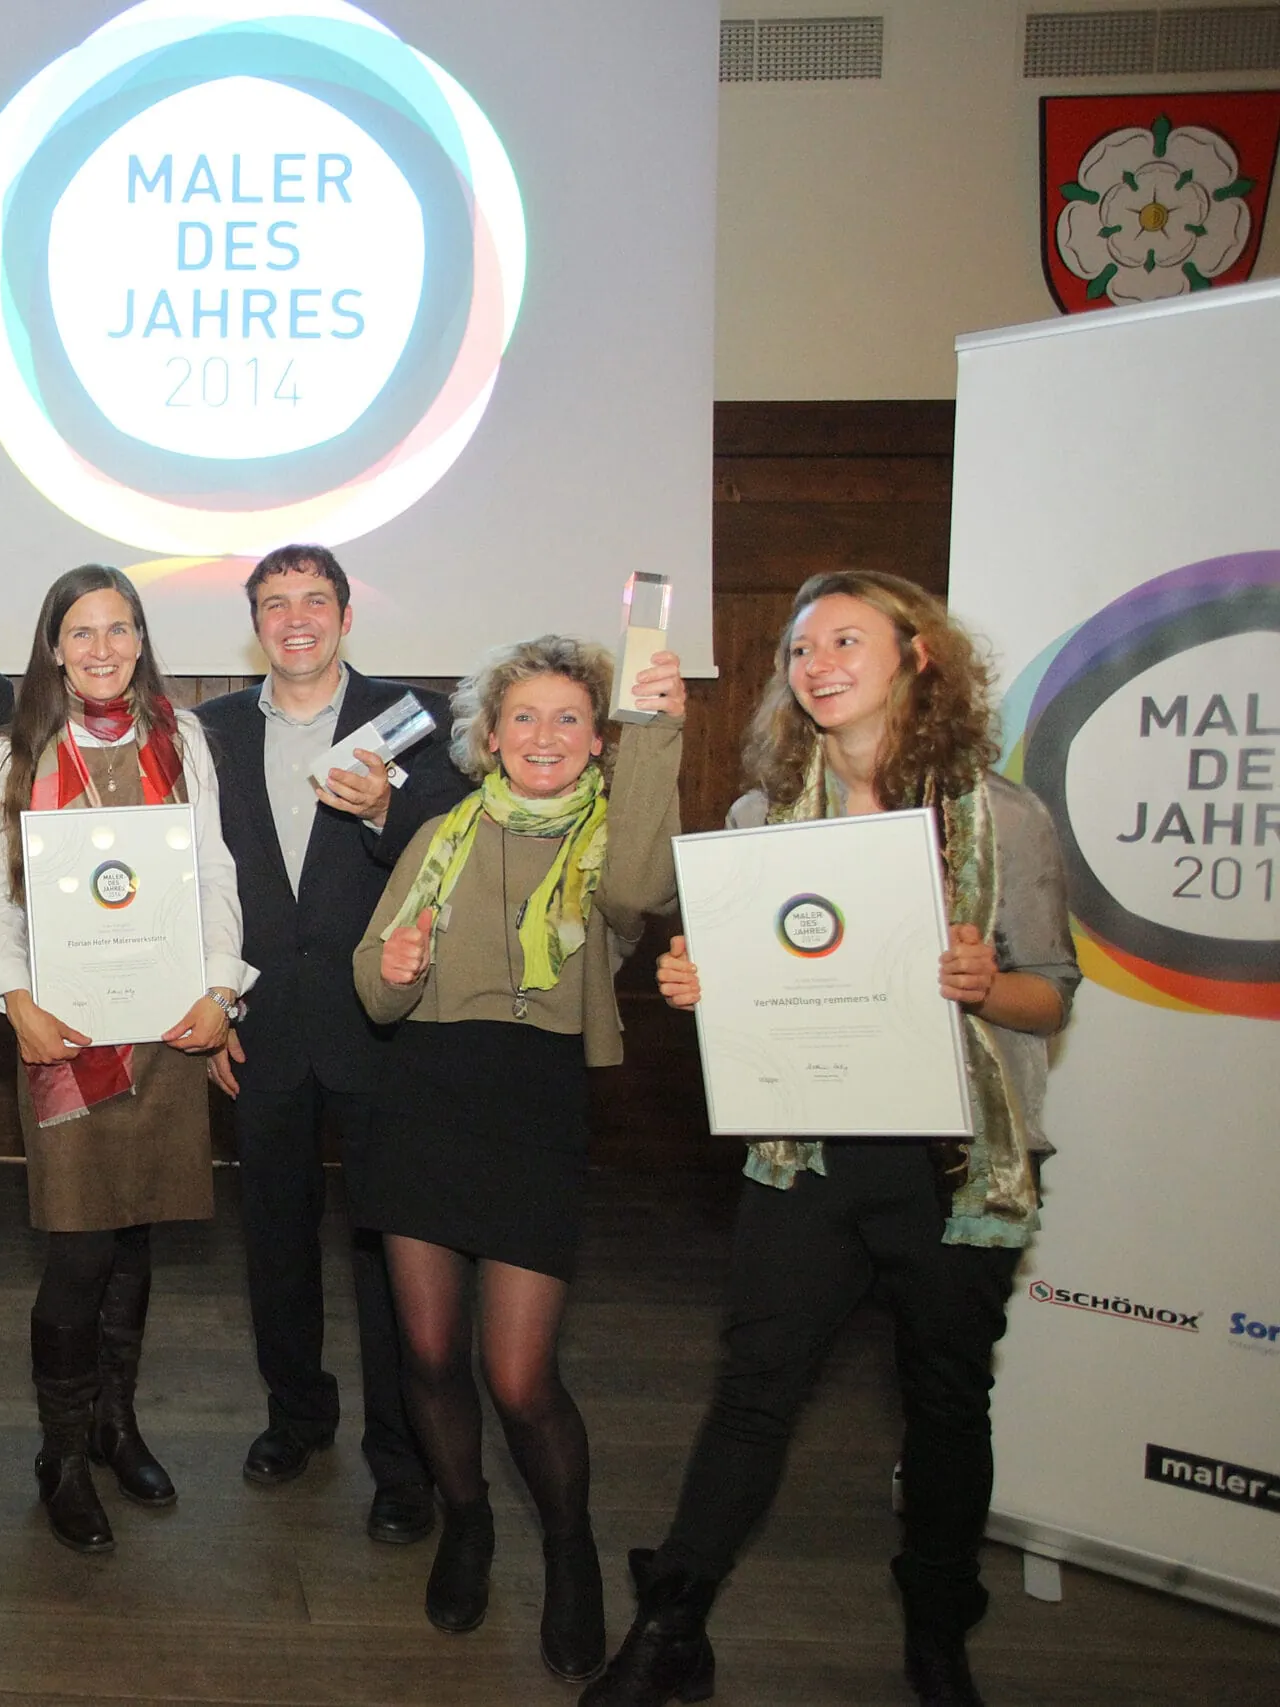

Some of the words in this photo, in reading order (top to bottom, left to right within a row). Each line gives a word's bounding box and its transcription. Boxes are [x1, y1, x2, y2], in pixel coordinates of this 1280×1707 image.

[128, 153, 353, 204] MALER
[177, 220, 300, 271] DES
[107, 288, 365, 340] JAHRES
[165, 356, 302, 407] 2014
[823, 995, 869, 1004] remmers
[872, 993, 887, 1002] KG
[1055, 1289, 1199, 1329] SCHÖNOX
